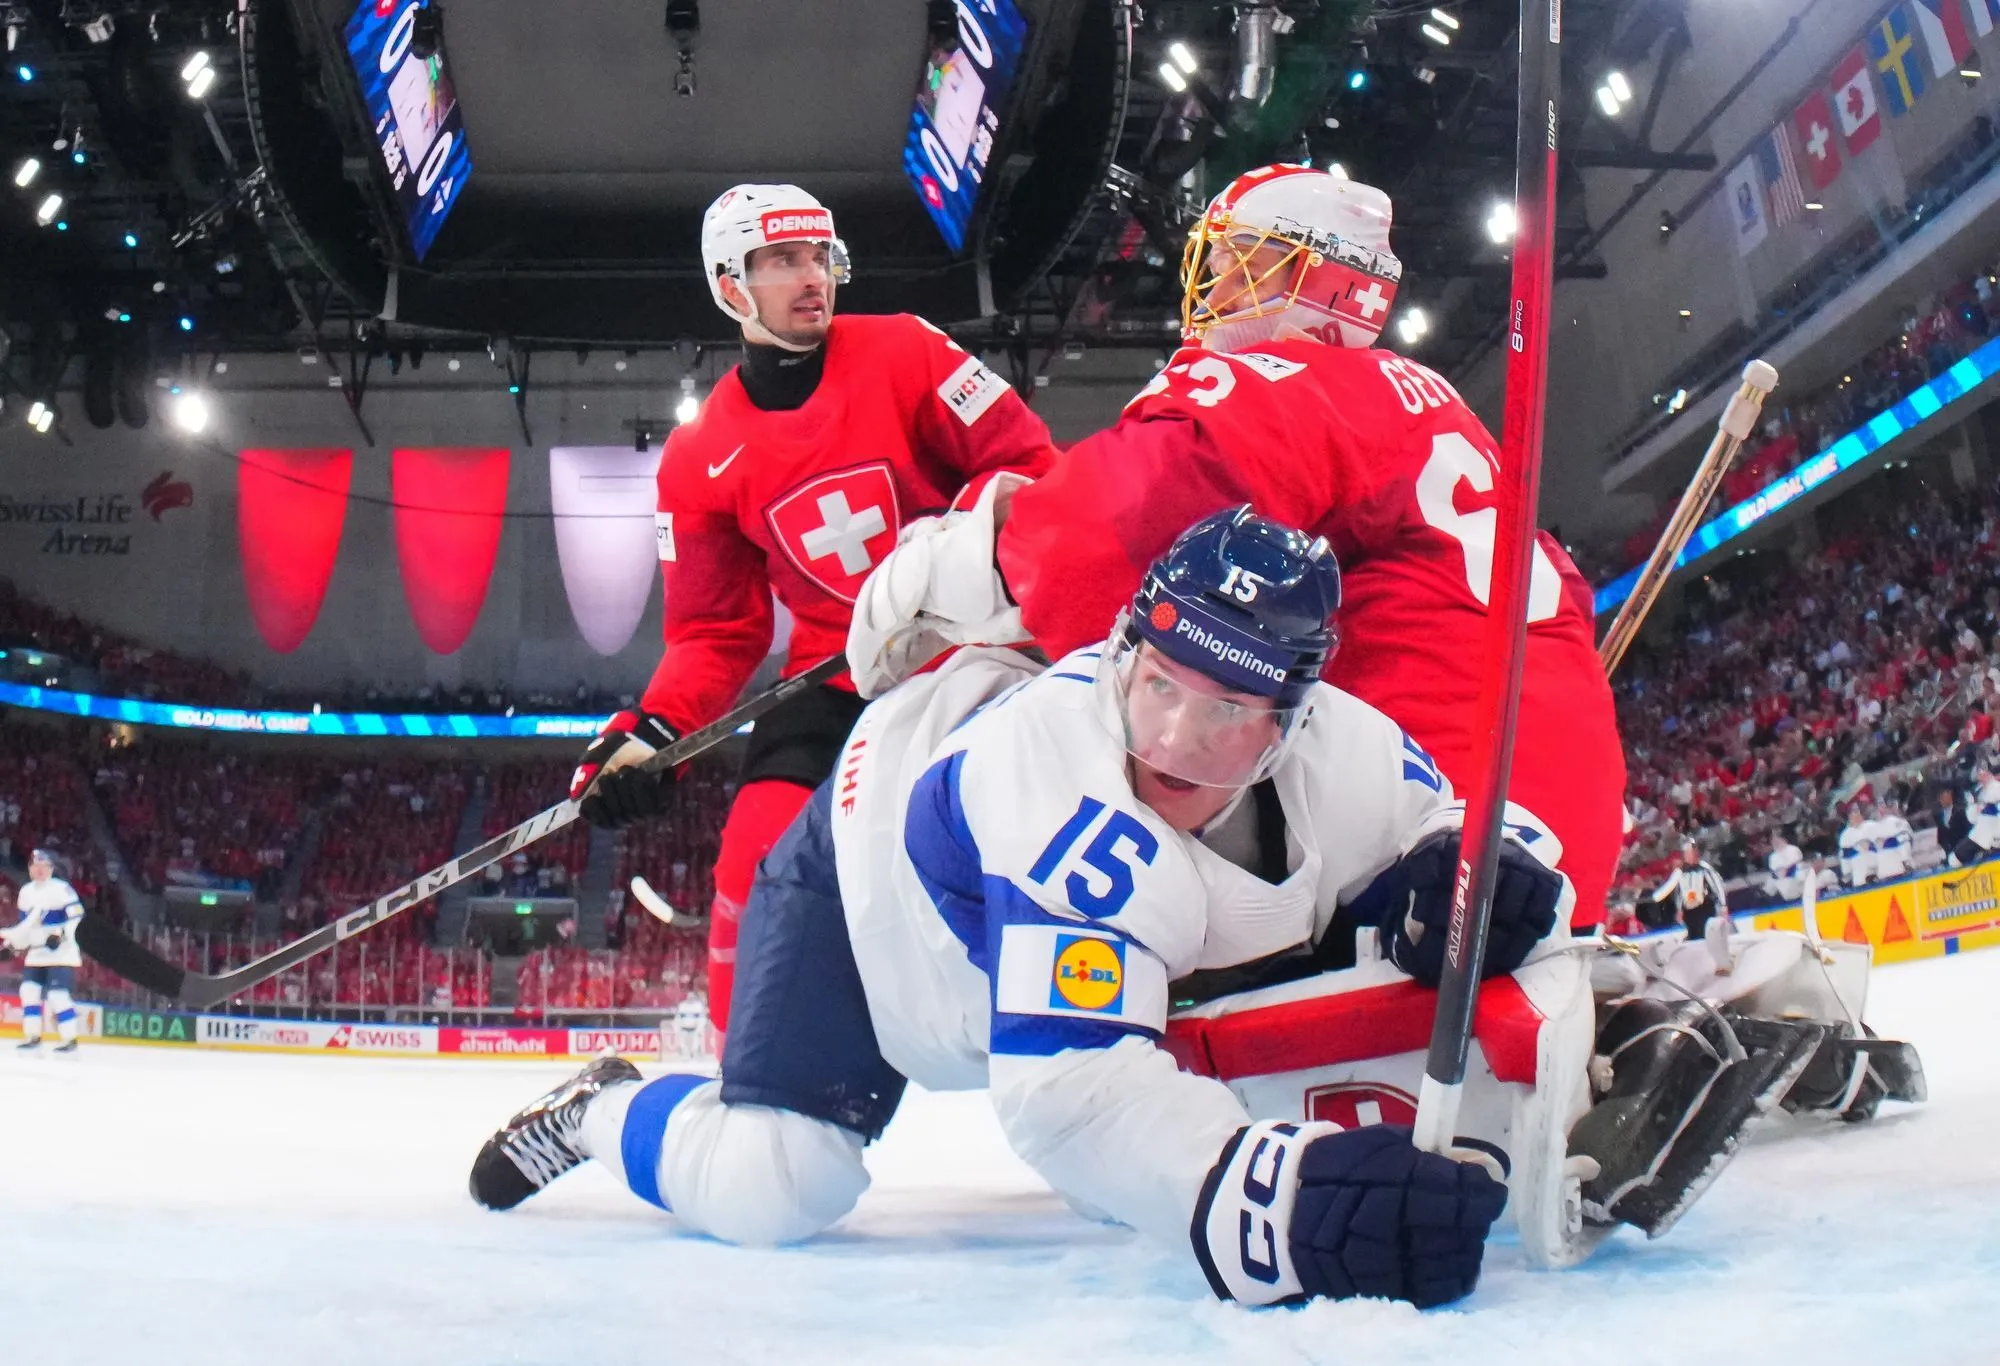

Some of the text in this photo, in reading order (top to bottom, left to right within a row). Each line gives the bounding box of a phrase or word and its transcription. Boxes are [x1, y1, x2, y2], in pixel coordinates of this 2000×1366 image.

[417, 131, 453, 196] 0
[921, 128, 959, 193] 0
[43, 527, 131, 555] Arena
[1219, 566, 1264, 603] 15
[1176, 618, 1287, 683] Pihlajalinna
[841, 740, 867, 817] IIHF
[1027, 795, 1159, 920] 15
[346, 868, 450, 934] CCM
[356, 1029, 421, 1047] SWISS
